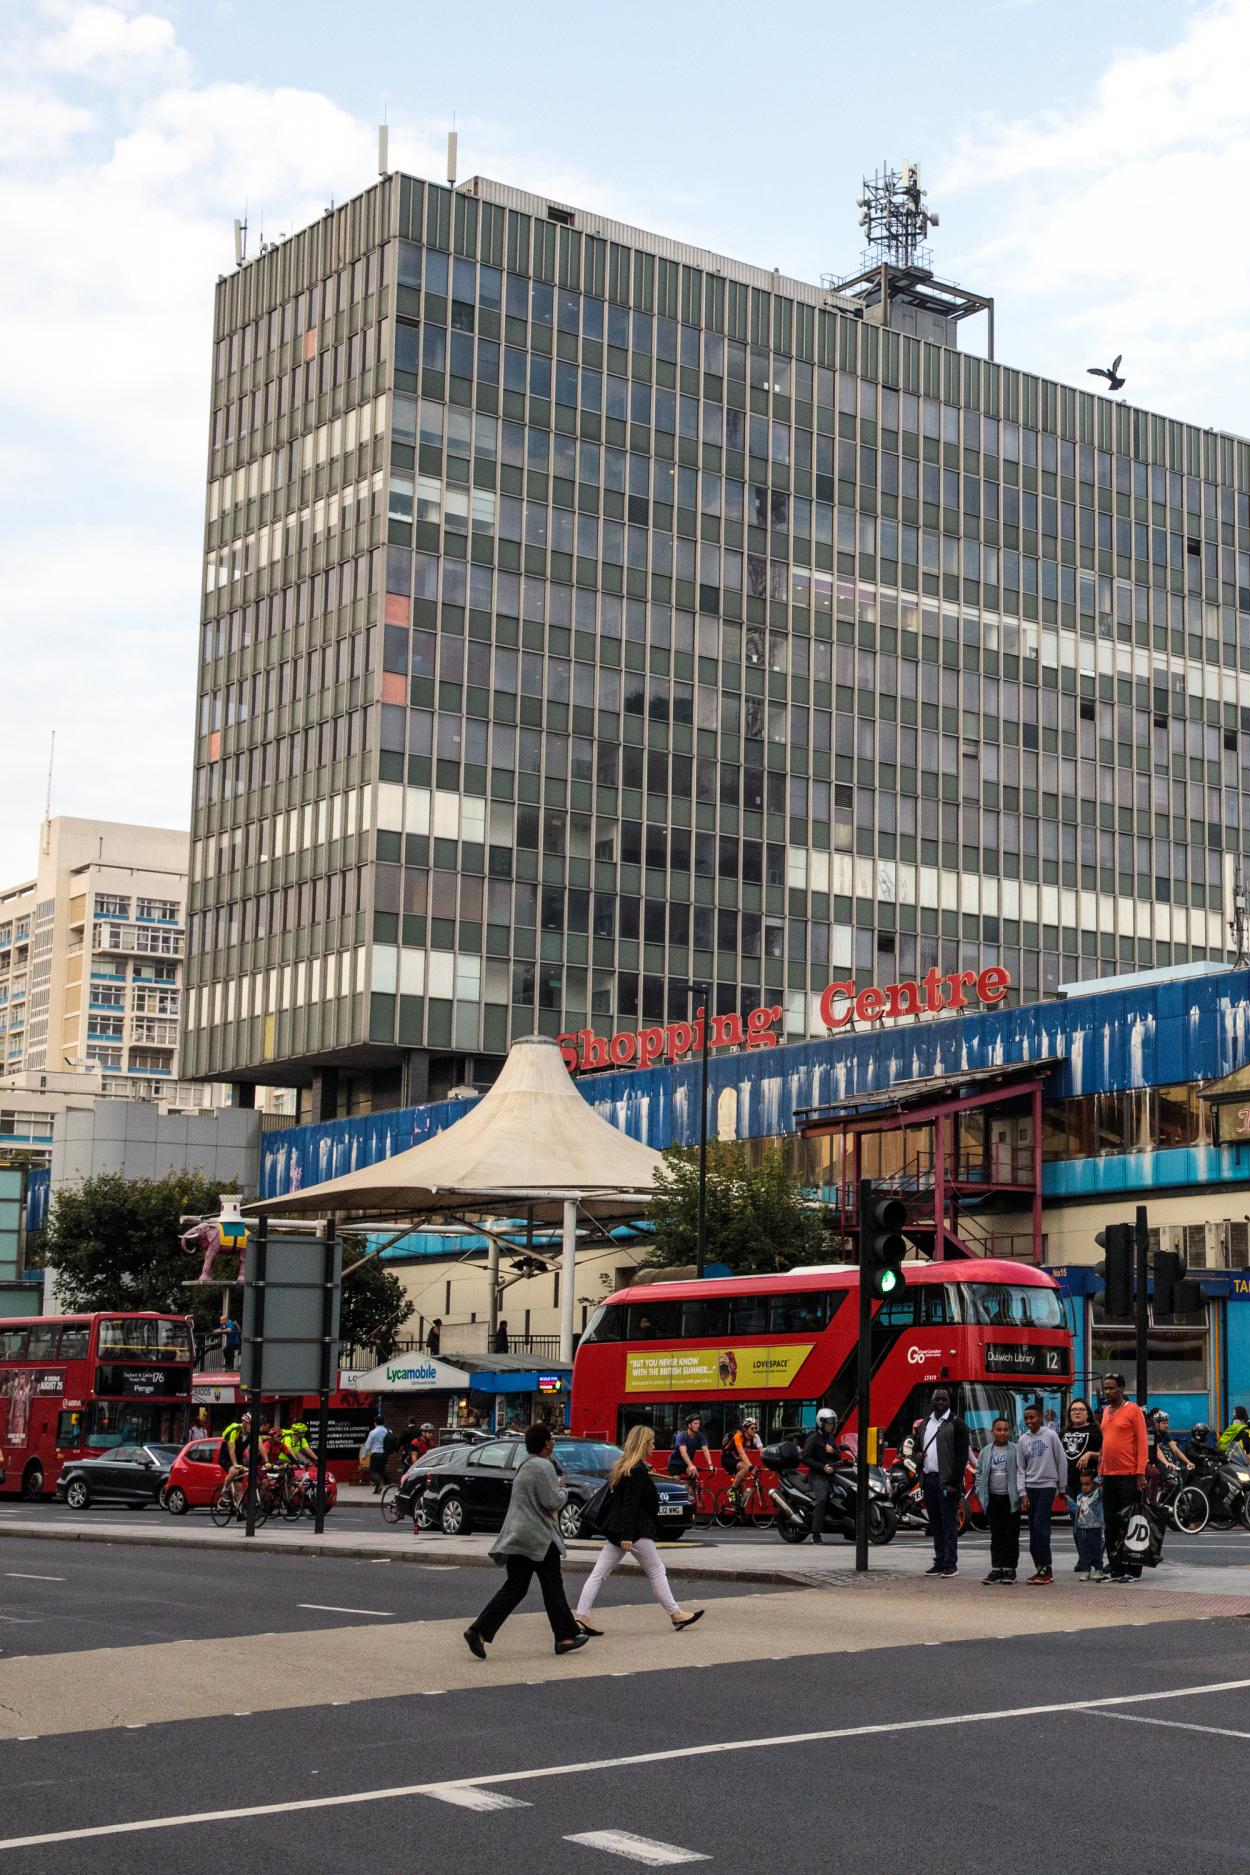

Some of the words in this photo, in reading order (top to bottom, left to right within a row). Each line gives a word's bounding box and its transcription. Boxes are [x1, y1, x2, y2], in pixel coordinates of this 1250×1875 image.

[556, 1004, 783, 1072] Shopping
[820, 966, 1010, 1029] Centre
[645, 1359, 658, 1367] YOU
[659, 1358, 677, 1366] NEVER
[679, 1357, 699, 1366] KNOW
[988, 1351, 1013, 1361] Dulwich
[1014, 1352, 1036, 1365] Library
[1046, 1351, 1059, 1369] 12
[152, 1372, 165, 1383] 176
[387, 1365, 437, 1383] Lycamobile
[633, 1368, 648, 1376] WITH
[649, 1367, 659, 1376] THE
[660, 1366, 682, 1375] BRITISH
[134, 1384, 154, 1394] Penge
[1126, 1523, 1149, 1542] JD
